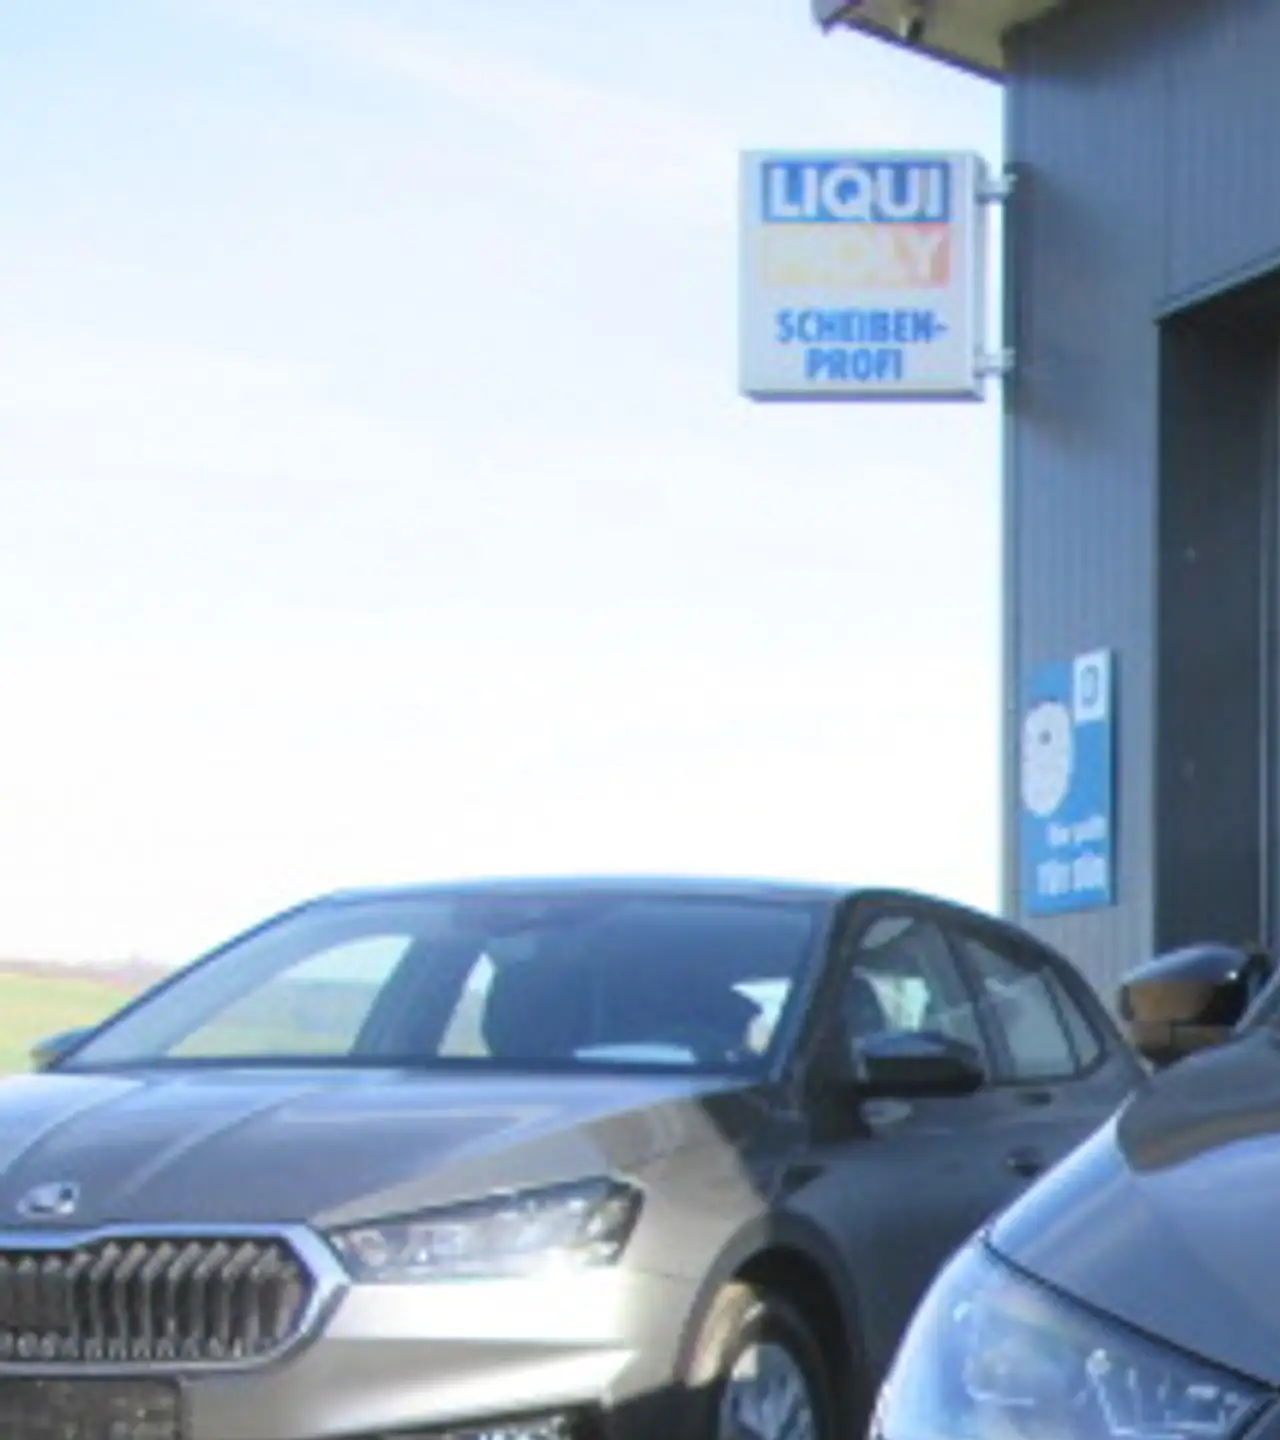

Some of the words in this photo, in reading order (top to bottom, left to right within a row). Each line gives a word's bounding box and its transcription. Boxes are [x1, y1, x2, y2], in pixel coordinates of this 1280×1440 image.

[768, 165, 944, 221] LIQUI
[768, 230, 944, 283] OLY
[775, 308, 948, 344] SCHEIBEN-
[804, 347, 903, 381] PROFI
